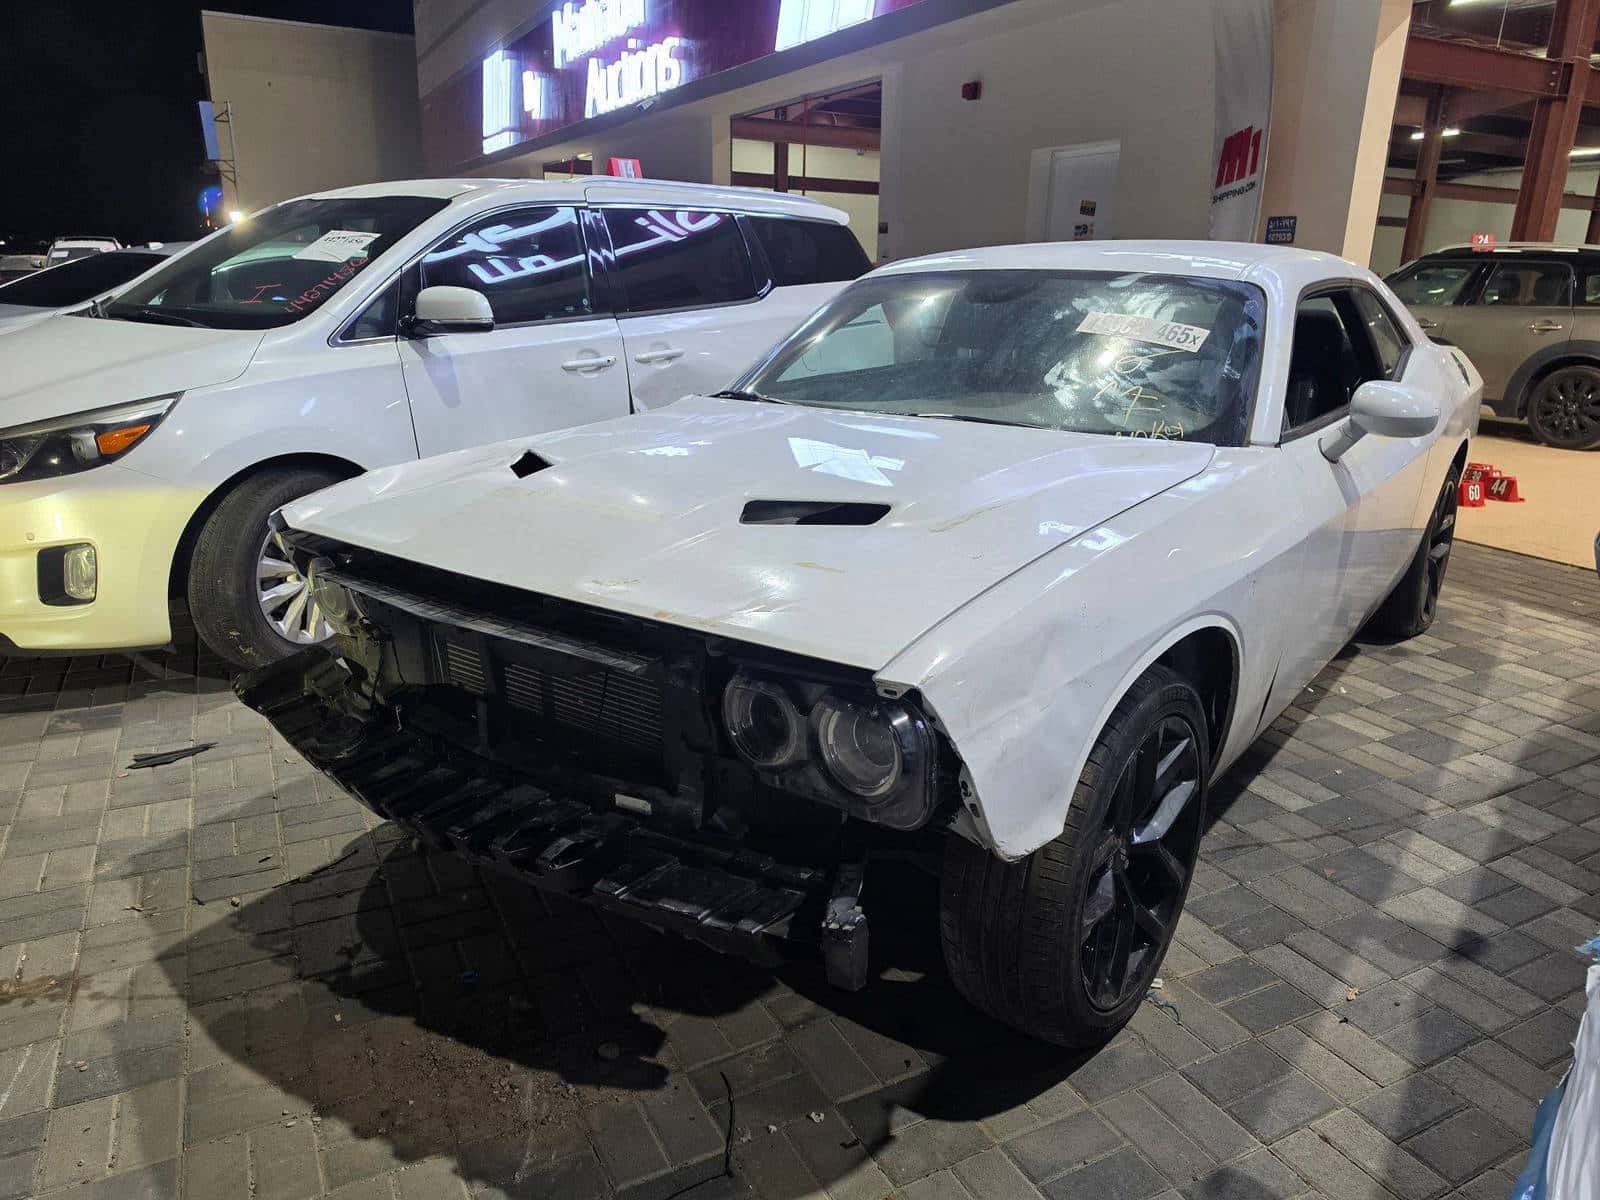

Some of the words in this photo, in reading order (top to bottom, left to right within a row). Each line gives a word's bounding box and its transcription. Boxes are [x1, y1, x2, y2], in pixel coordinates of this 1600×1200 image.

[584, 37, 681, 119] Auctions
[1215, 126, 1262, 189] M1
[1468, 484, 1480, 501] 60
